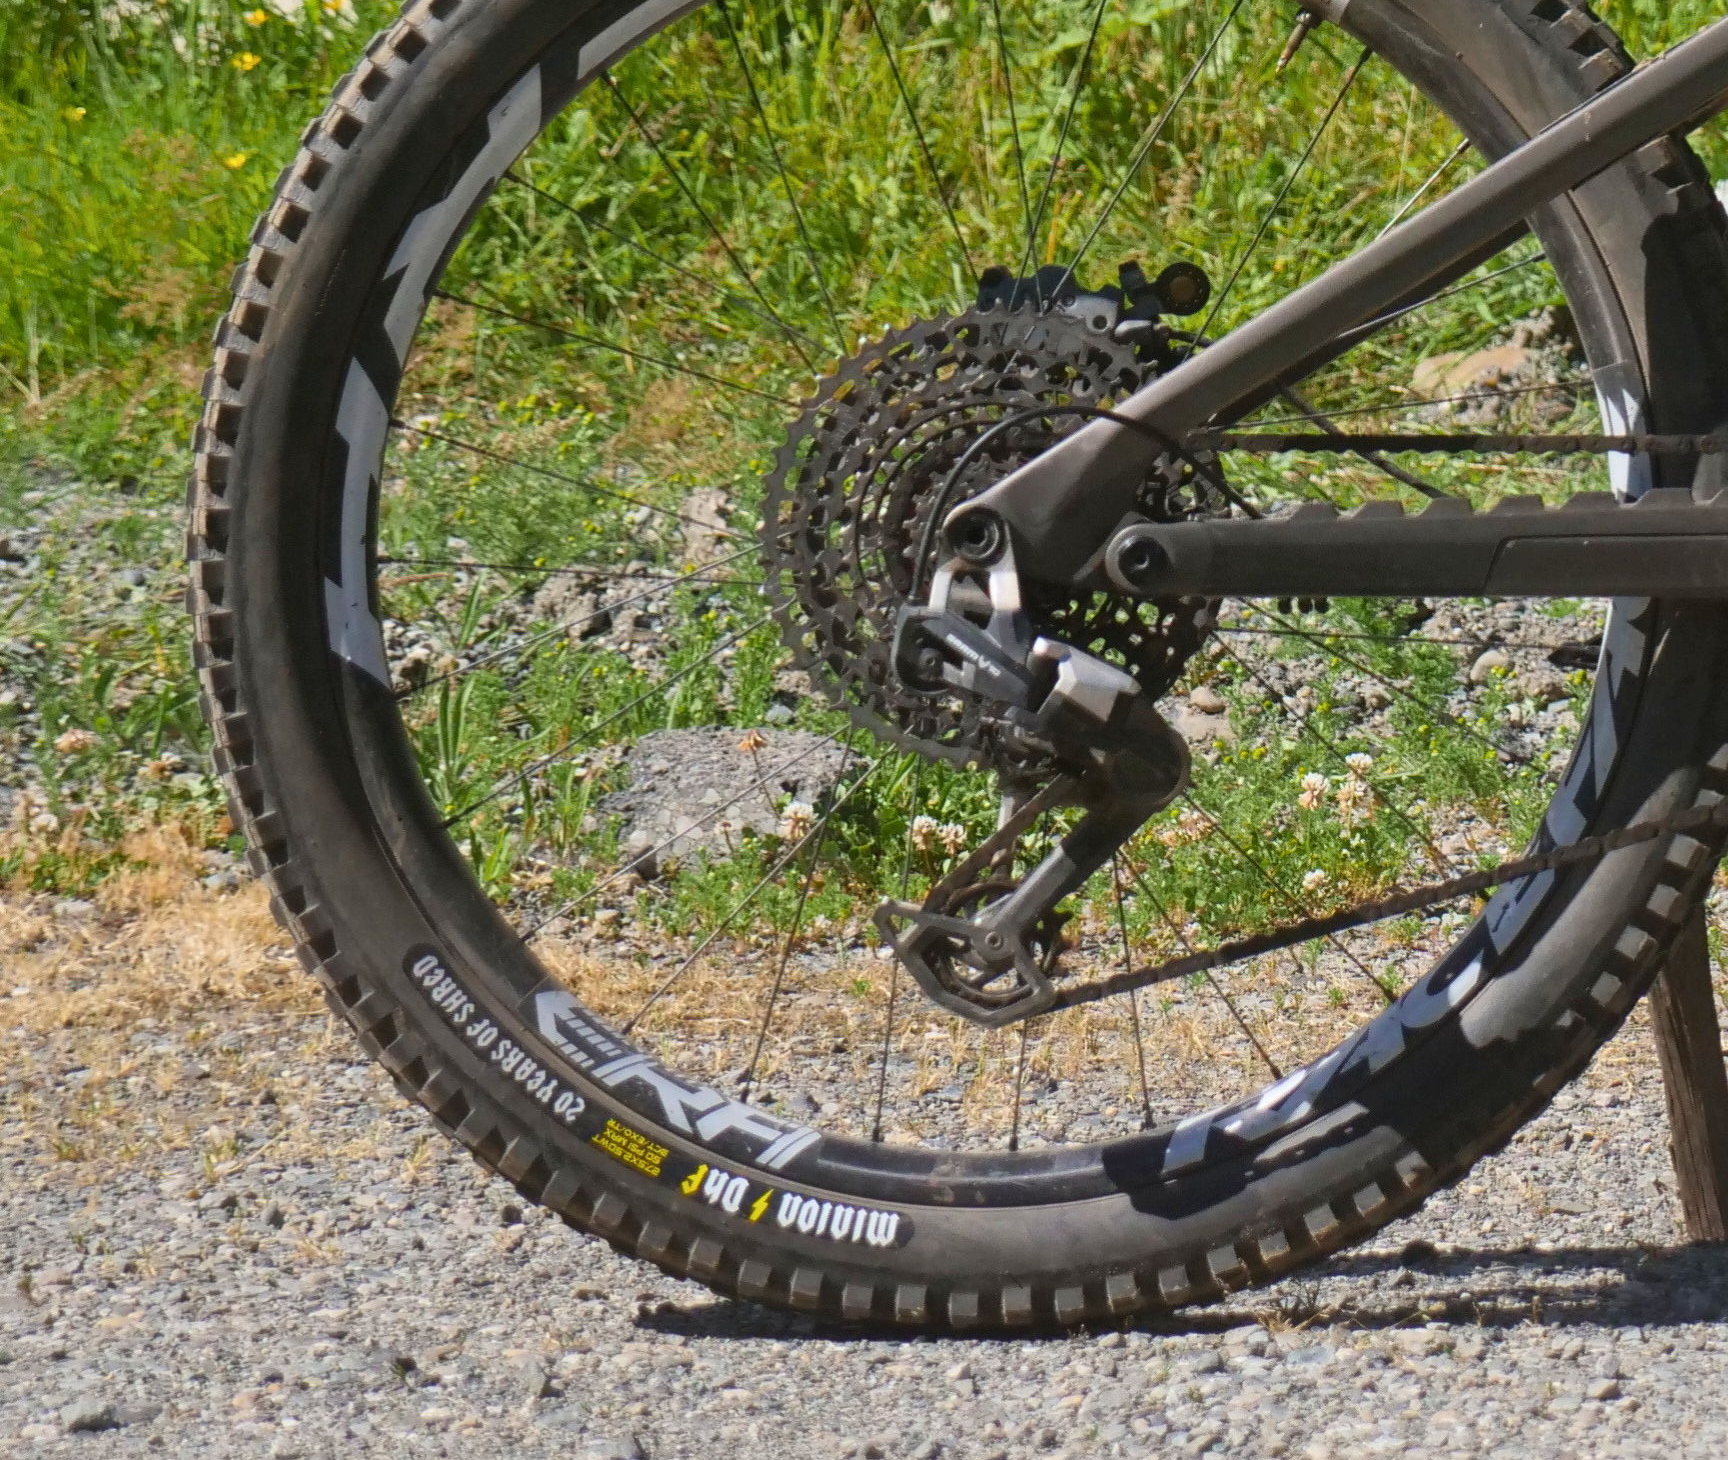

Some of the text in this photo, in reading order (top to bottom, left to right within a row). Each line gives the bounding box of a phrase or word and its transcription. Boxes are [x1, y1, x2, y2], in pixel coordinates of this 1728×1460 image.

[413, 955, 585, 1121] 20 YEARS OF SHRED
[604, 1128, 628, 1146] MAX
[627, 1142, 646, 1156] PSI
[776, 1190, 902, 1248] MINION
